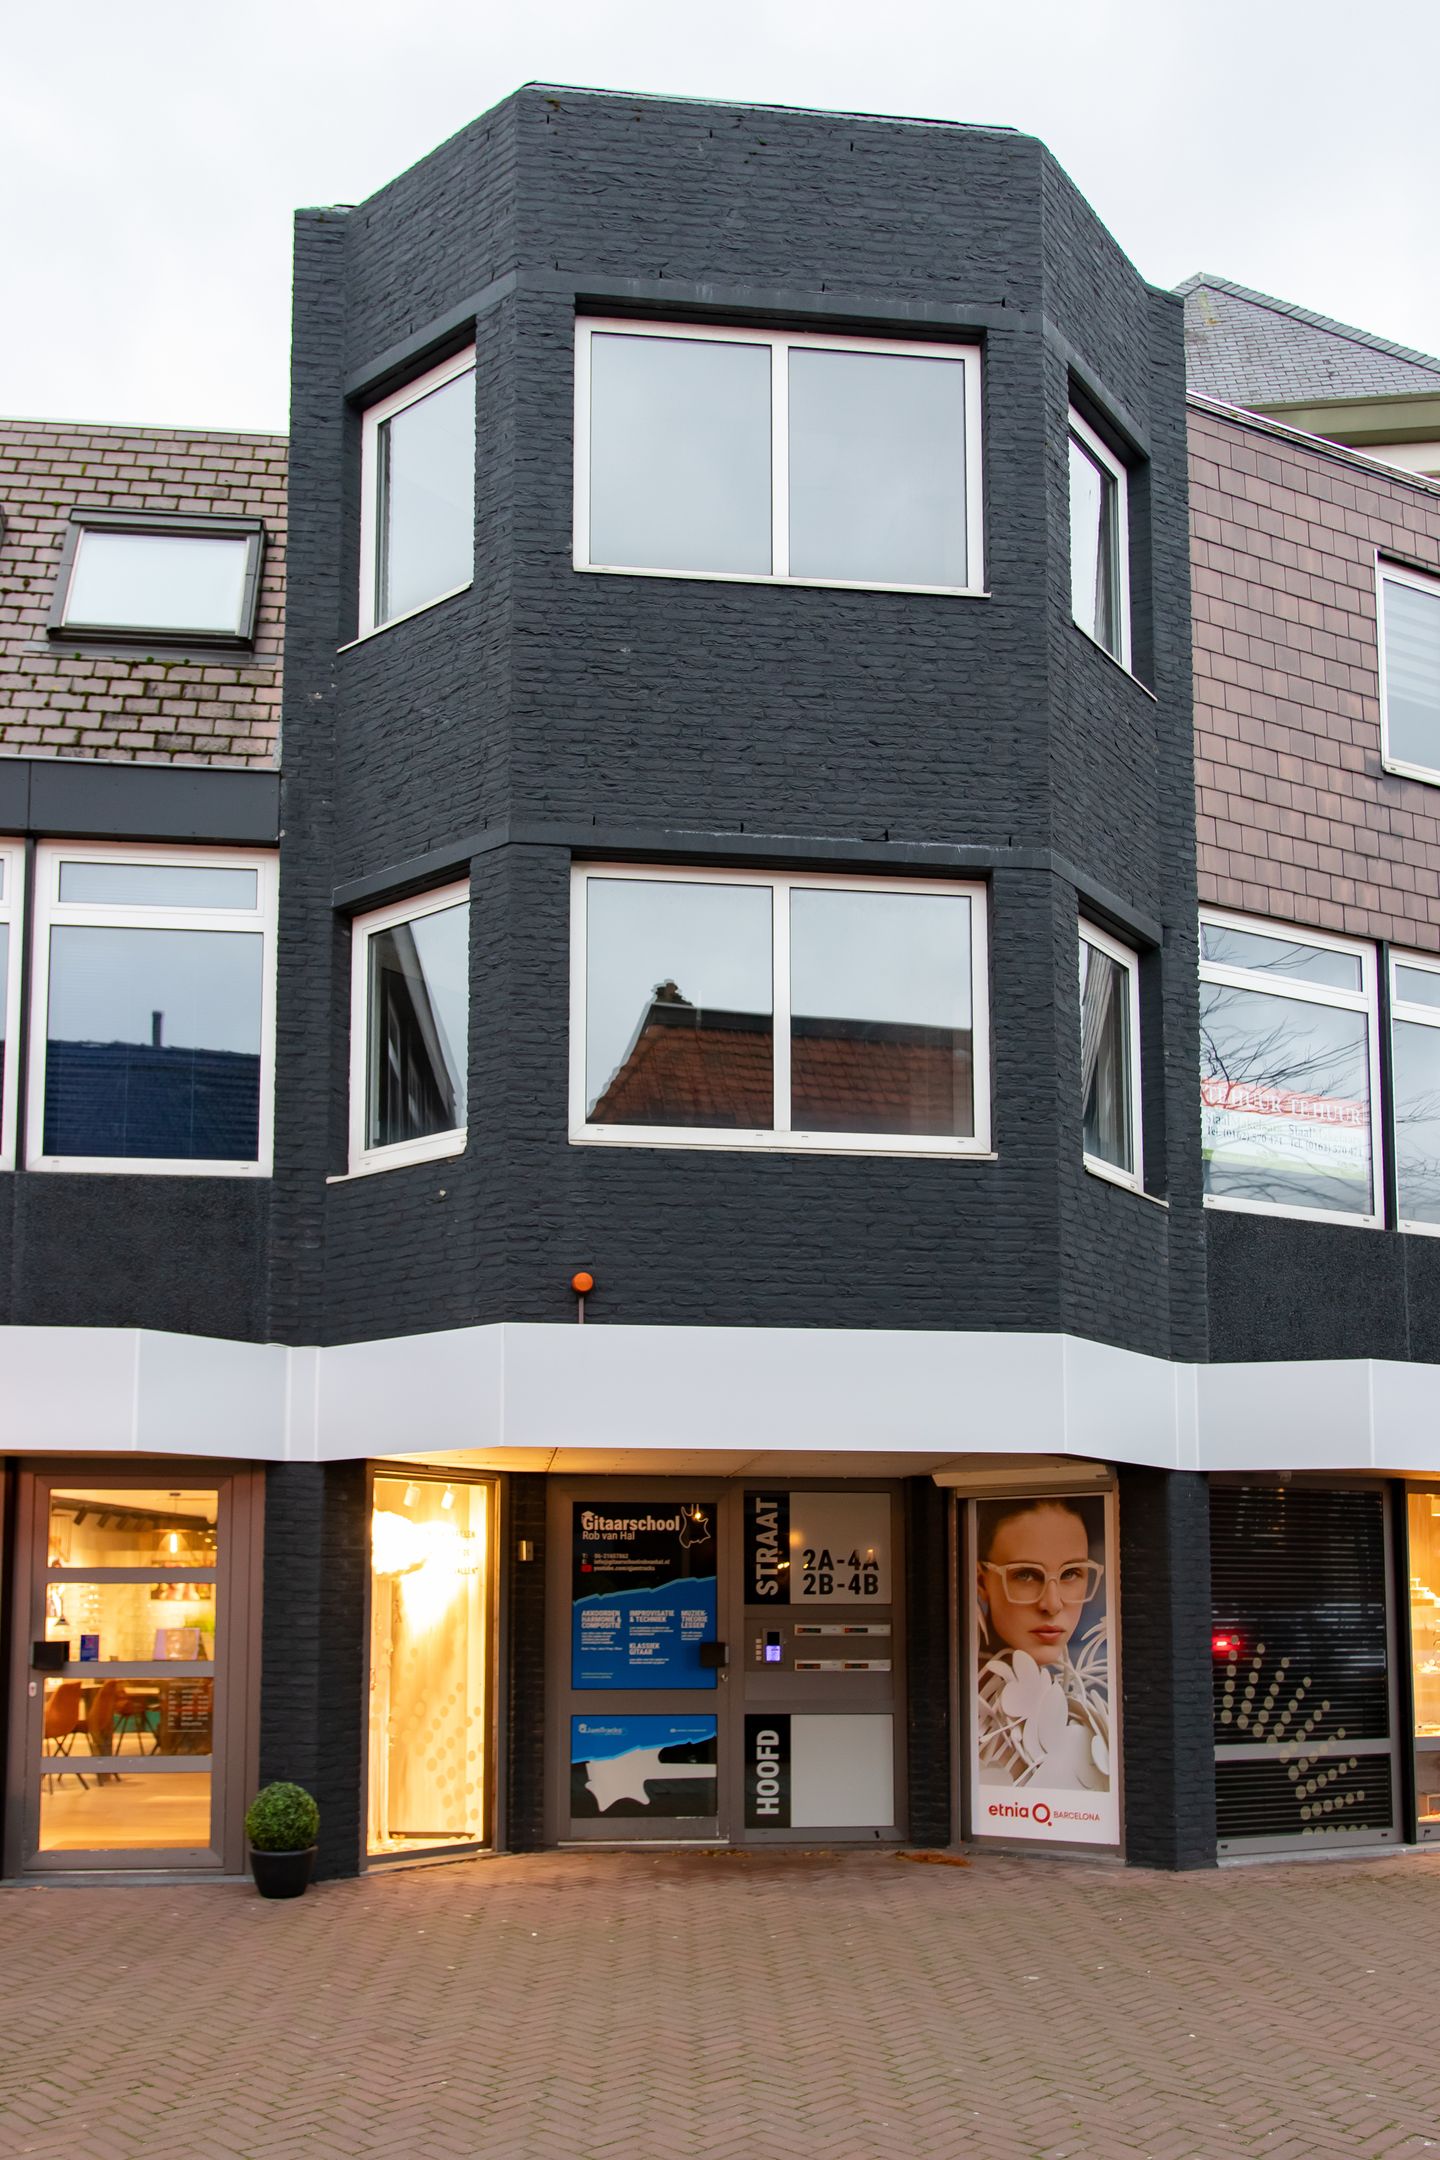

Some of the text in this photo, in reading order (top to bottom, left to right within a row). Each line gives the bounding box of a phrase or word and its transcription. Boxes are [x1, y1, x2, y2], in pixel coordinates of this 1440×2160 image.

[583, 1515, 680, 1531] Gitaarschool
[582, 1531, 600, 1540] Rob
[620, 1531, 635, 1540] Hal
[756, 1498, 779, 1596] STRAAT
[803, 1549, 879, 1571] 2A-4A
[803, 1573, 879, 1595] 2B-4B
[756, 1729, 780, 1815] HOOFD
[988, 1802, 1101, 1821] etnia BARCELONA
